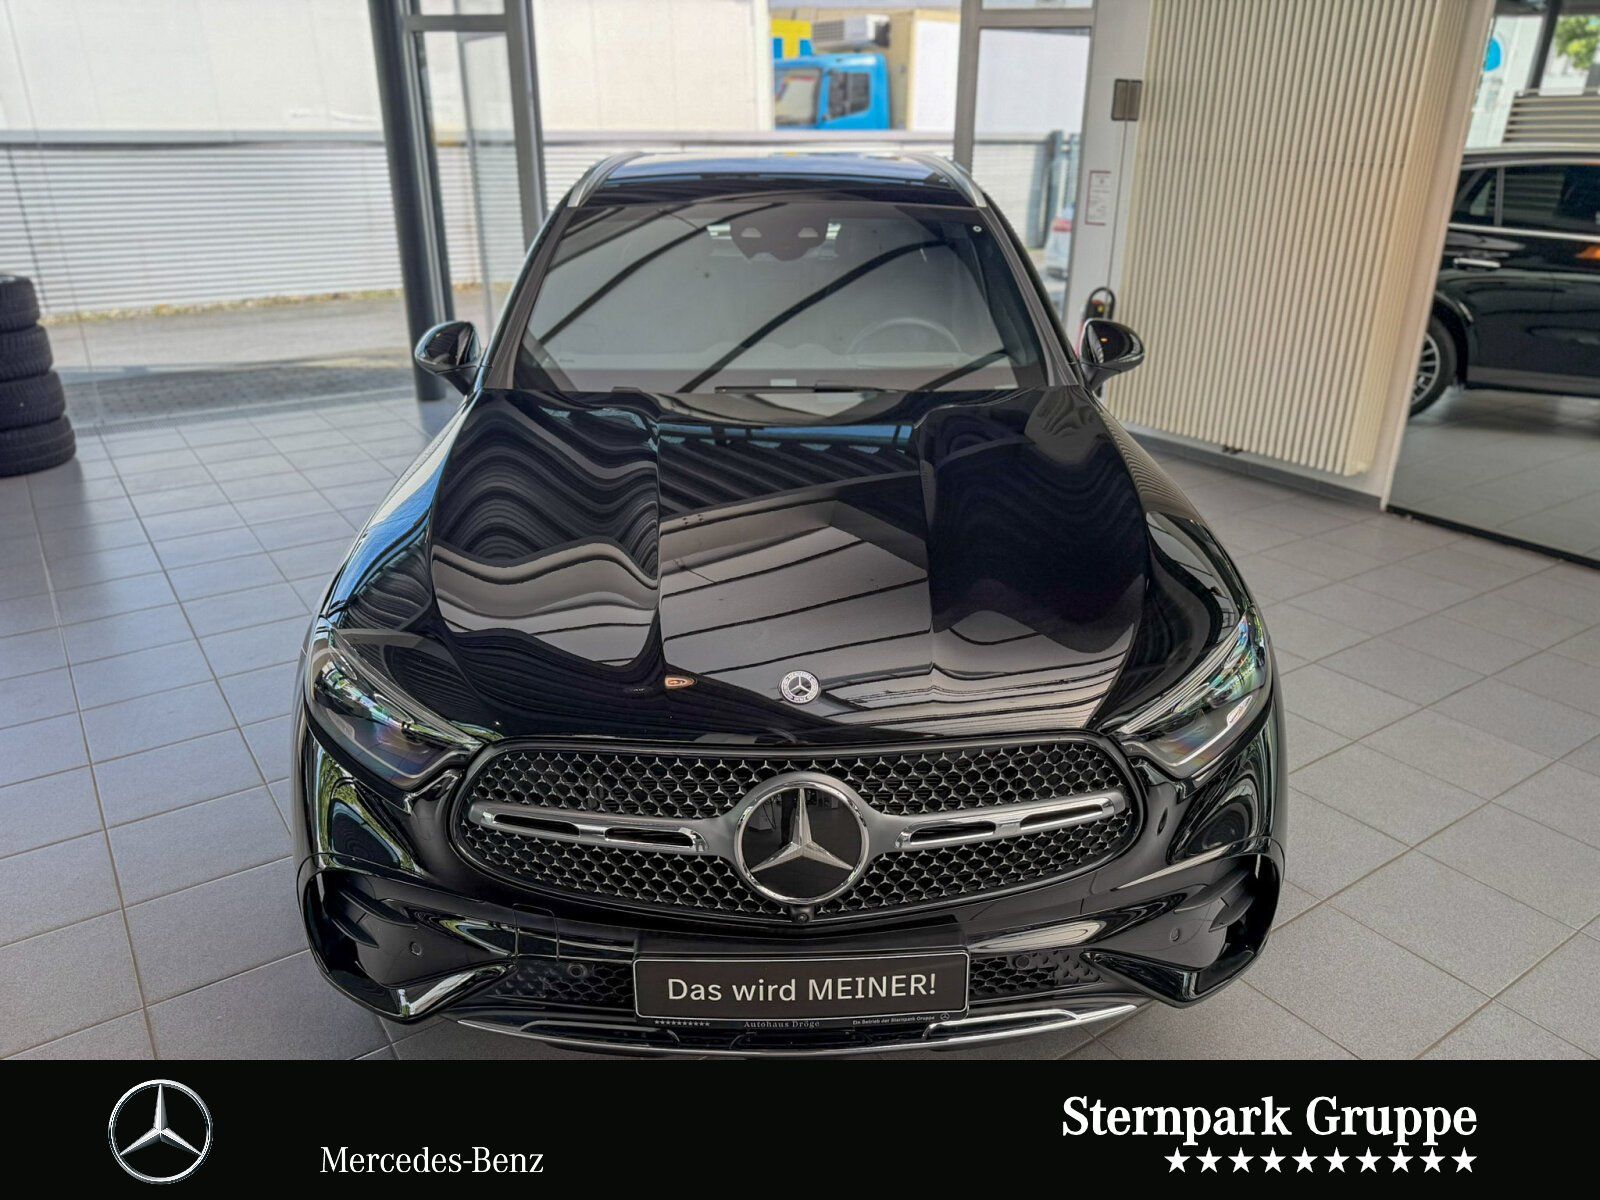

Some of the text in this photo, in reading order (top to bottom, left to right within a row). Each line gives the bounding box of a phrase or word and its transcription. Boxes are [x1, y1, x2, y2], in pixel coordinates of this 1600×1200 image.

[668, 973, 936, 1001] Das wird MEINER!
[743, 1020, 789, 1028] Autohaus
